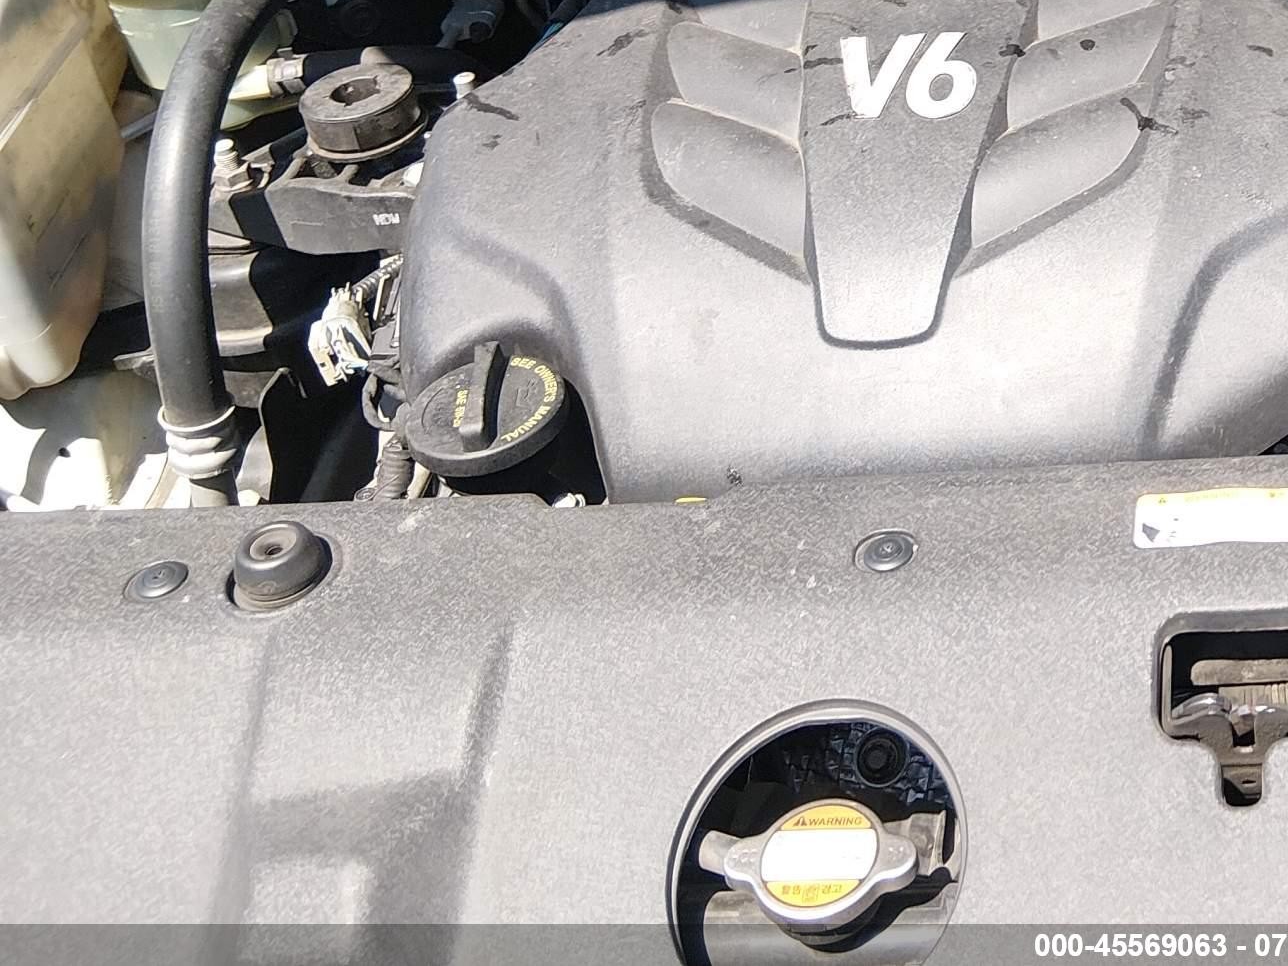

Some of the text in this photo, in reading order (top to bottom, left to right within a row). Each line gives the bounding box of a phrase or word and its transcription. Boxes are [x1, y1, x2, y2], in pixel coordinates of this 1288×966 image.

[839, 32, 977, 119] V6
[510, 357, 537, 369] SEE
[500, 405, 552, 442] MANUAL
[808, 817, 862, 826] WARNING
